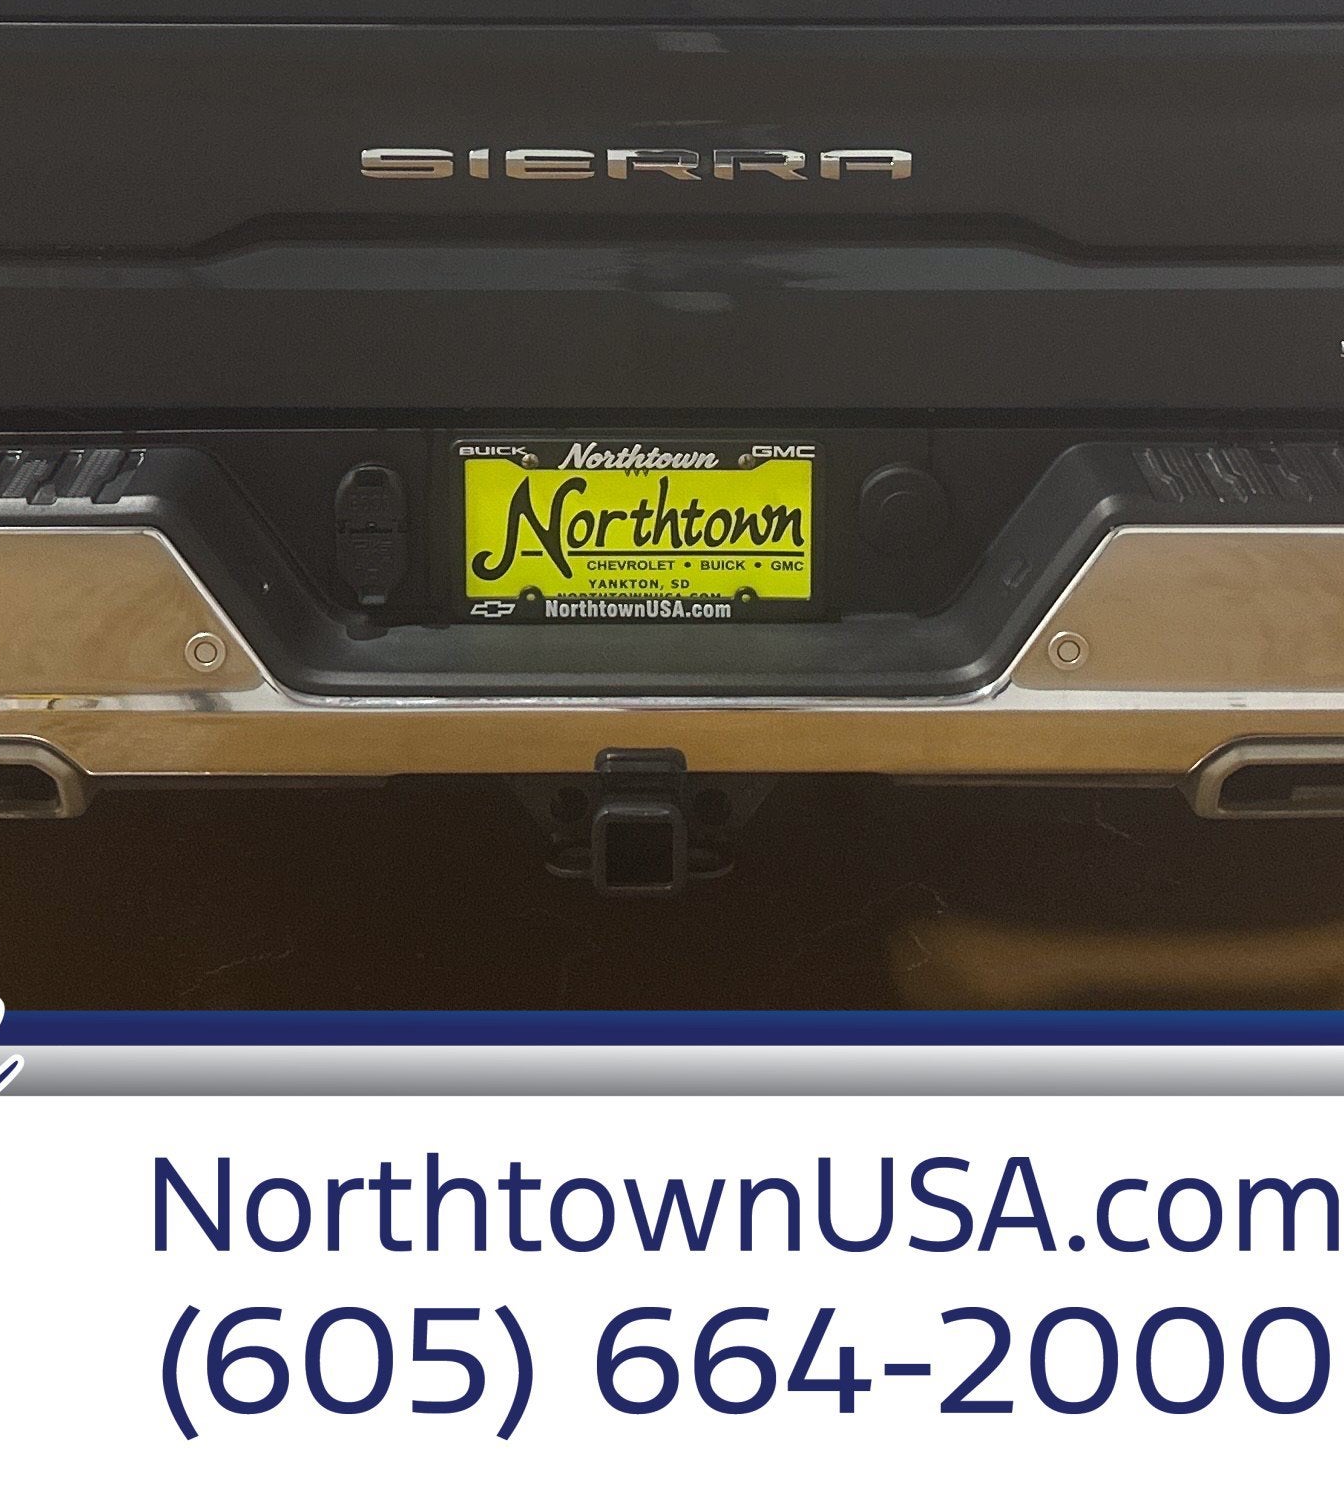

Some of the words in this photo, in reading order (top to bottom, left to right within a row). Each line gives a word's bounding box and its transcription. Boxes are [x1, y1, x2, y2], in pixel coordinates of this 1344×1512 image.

[360, 147, 915, 181] SIERRA
[459, 445, 527, 457] BUICK
[558, 442, 720, 471] Northtown
[751, 445, 816, 459] GMC
[471, 475, 806, 581] Northtown
[586, 560, 675, 572] CHEVROLET
[700, 560, 746, 572] BUICK
[770, 560, 805, 572] GMC
[588, 579, 666, 591] YANKTON,
[671, 578, 690, 589] SD
[545, 600, 732, 619] NorthtownUSA.com
